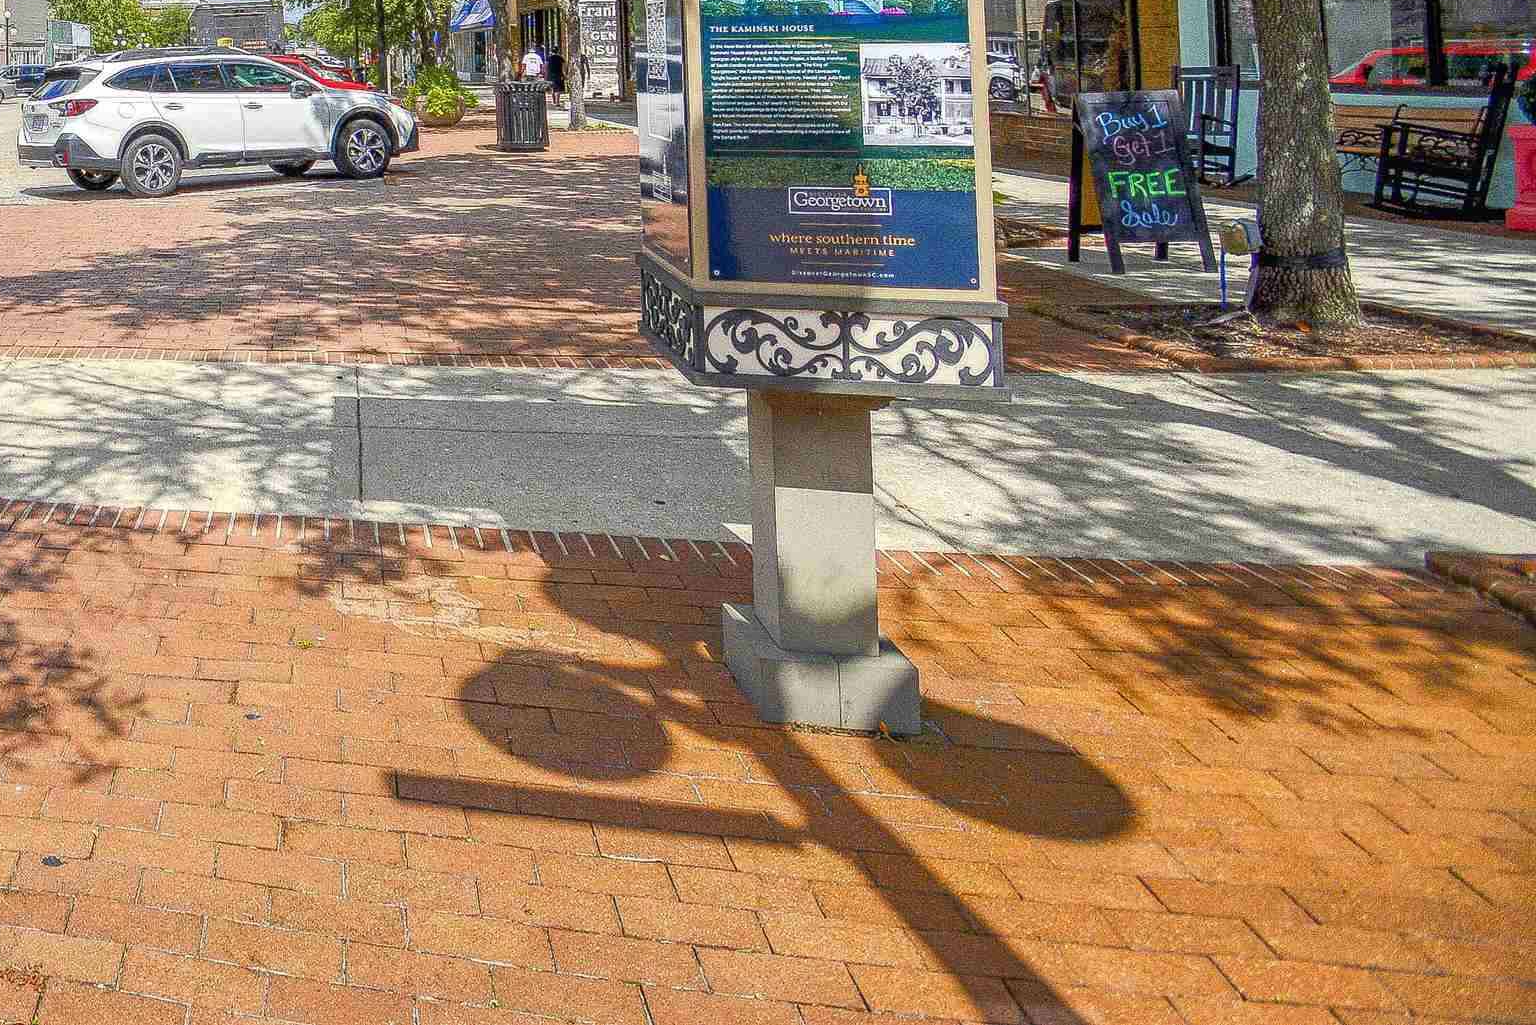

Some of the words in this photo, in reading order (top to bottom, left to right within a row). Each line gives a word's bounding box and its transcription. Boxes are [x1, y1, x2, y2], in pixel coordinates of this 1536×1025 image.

[731, 24, 779, 32] KAMINSKI
[781, 24, 815, 32] HOUSE
[1096, 111, 1149, 137] Buy
[1148, 103, 1168, 128] 1
[1114, 132, 1152, 166] Get
[1107, 168, 1186, 198] FREE
[793, 191, 887, 212] Georgetown
[1120, 199, 1178, 228] Sale
[769, 232, 813, 244] where
[816, 233, 880, 245] southern
[882, 234, 916, 247] time
[790, 247, 828, 255] MEETS
[833, 248, 896, 257] MARITIME
